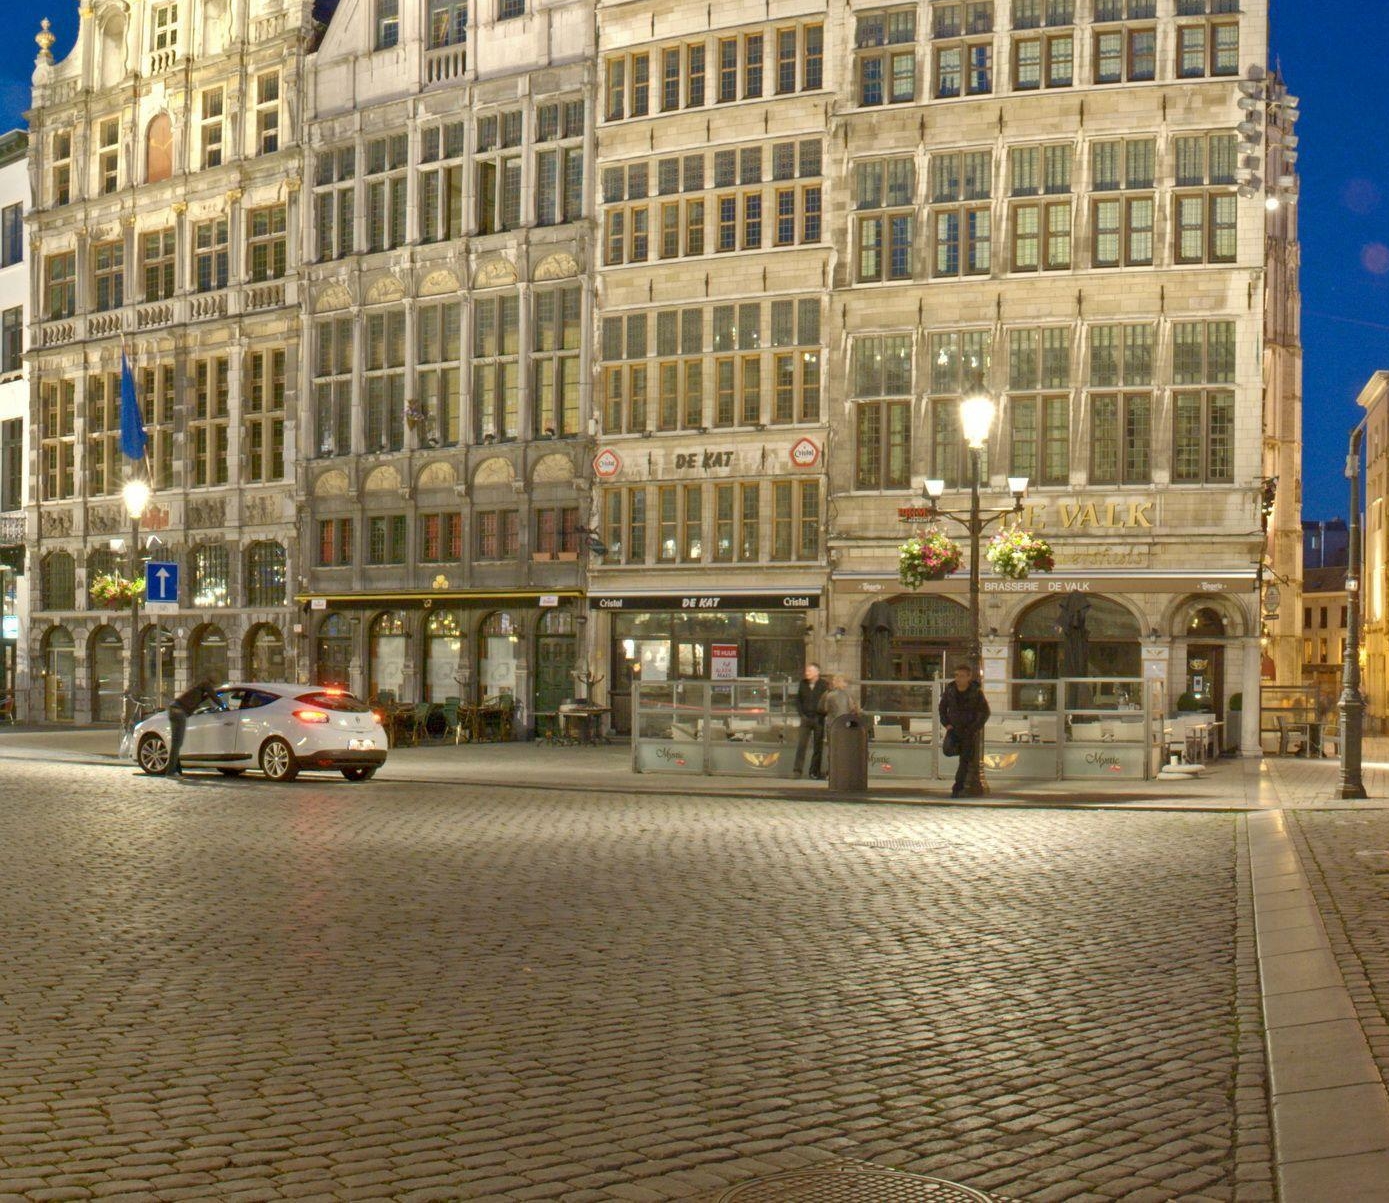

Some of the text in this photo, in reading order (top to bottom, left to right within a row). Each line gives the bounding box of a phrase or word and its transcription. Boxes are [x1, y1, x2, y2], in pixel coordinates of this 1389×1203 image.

[675, 450, 734, 469] DE KAT
[1059, 501, 1154, 529] VALK
[984, 582, 1090, 592] BRASSERIE DE VALK
[600, 598, 623, 608] Cristal
[682, 597, 721, 608] DE KAT
[783, 597, 809, 607] Cristal
